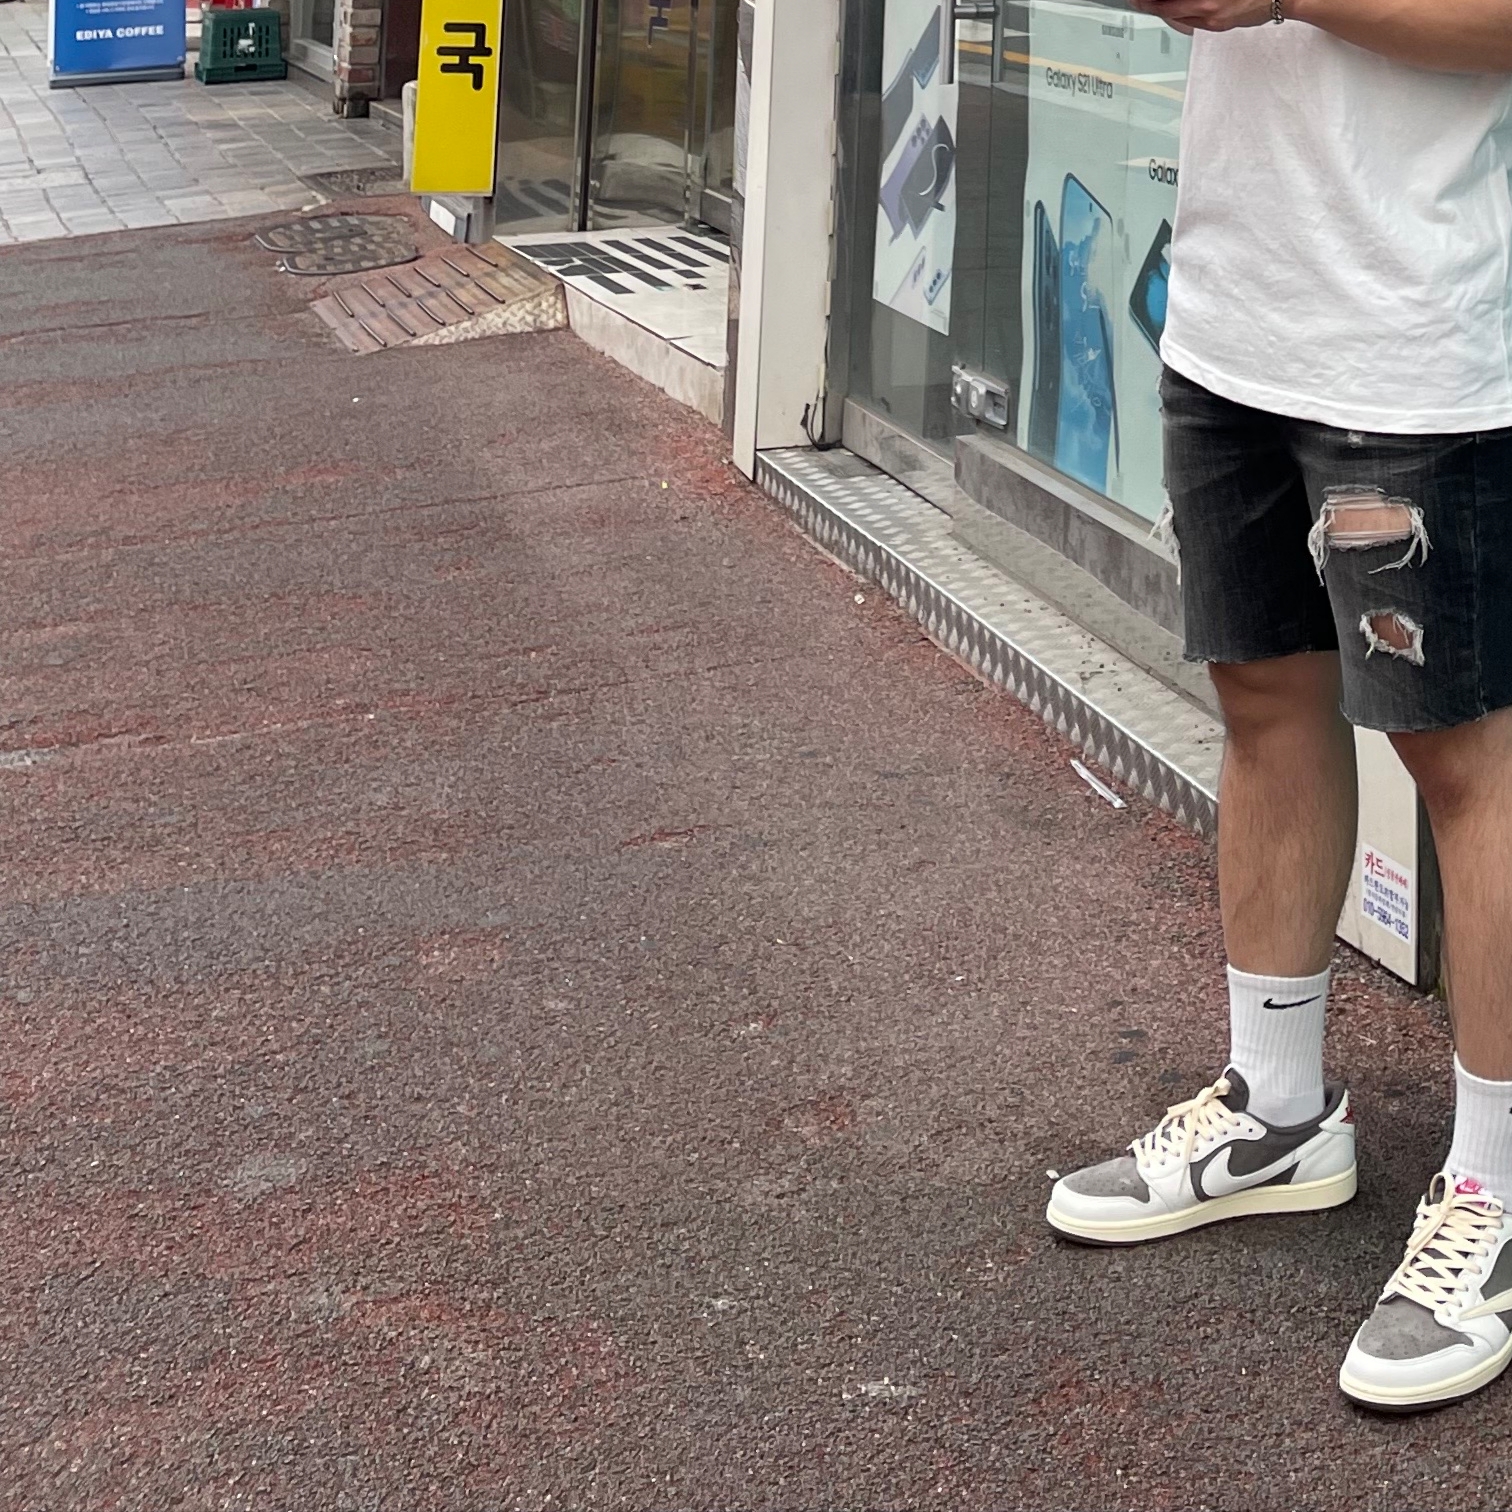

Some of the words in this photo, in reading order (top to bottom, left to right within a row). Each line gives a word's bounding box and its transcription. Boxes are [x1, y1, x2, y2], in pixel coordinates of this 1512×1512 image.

[76, 29, 113, 42] EDIYA
[116, 24, 165, 39] COFFEE
[1046, 66, 1077, 98] Galaxy
[1092, 76, 1114, 99] Ultra
[1149, 157, 1179, 187] Galax
